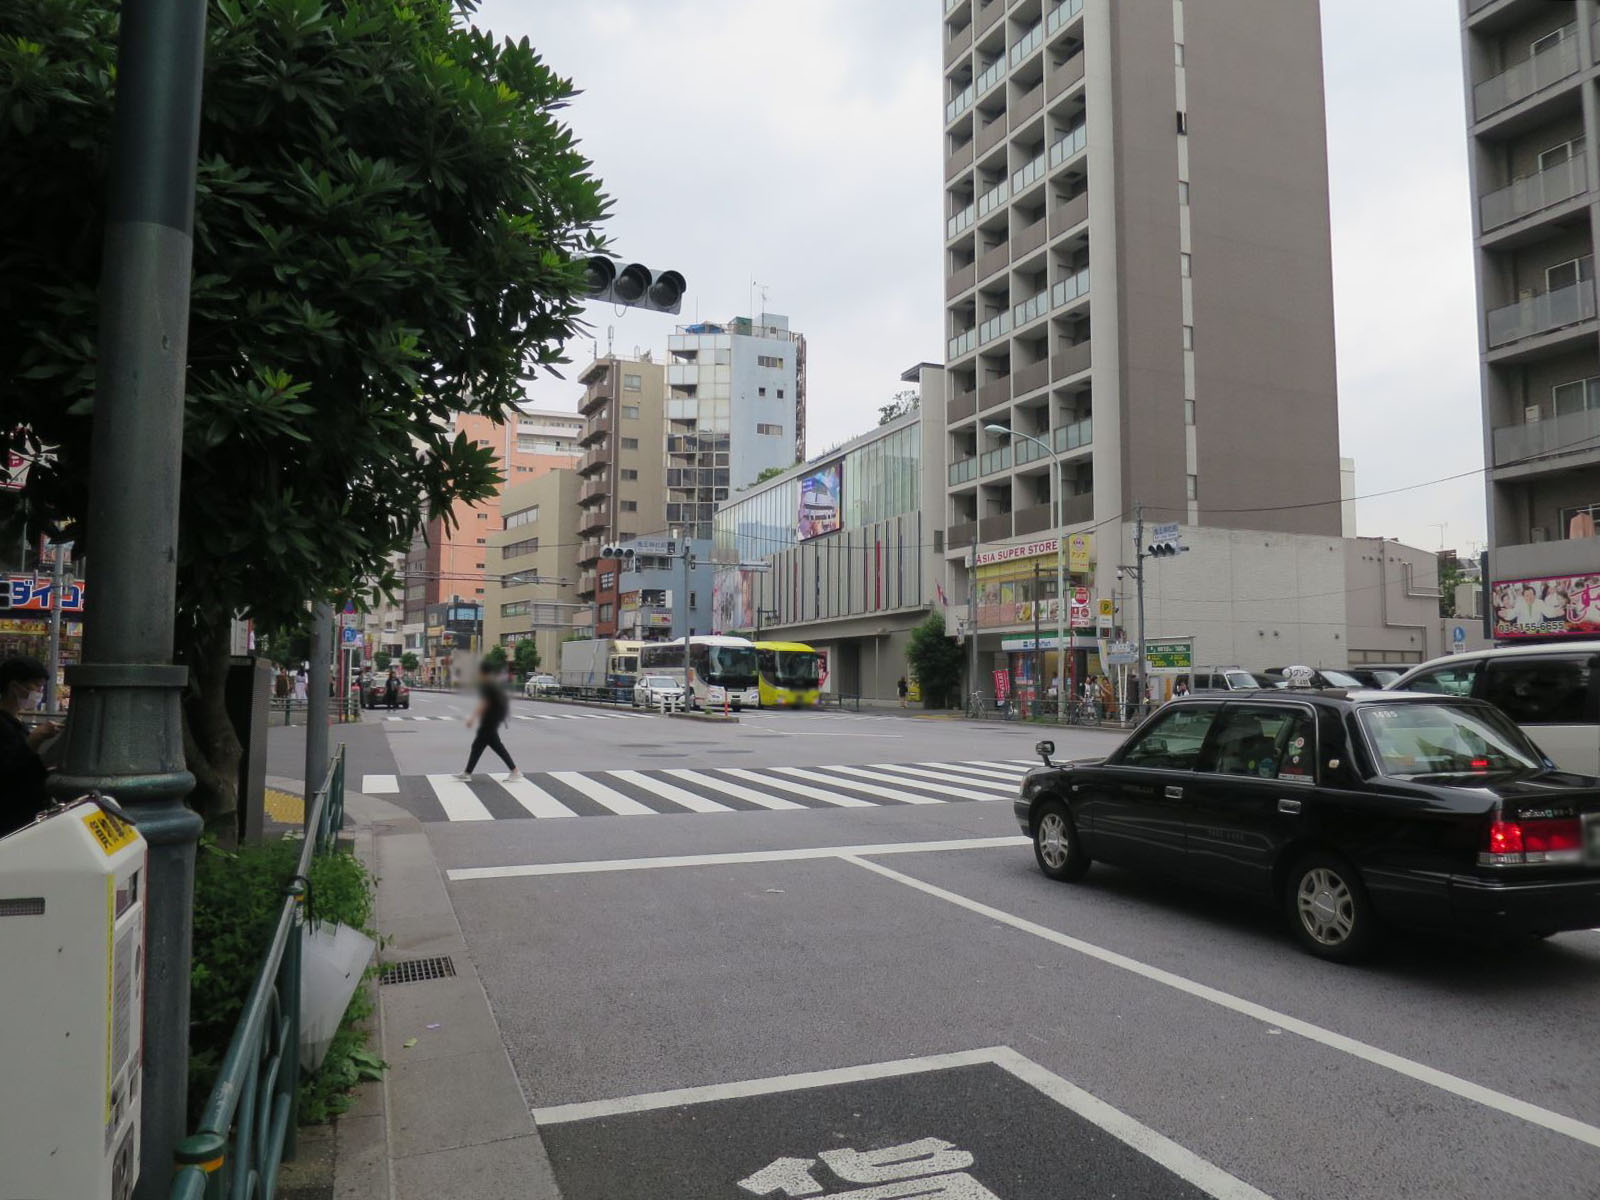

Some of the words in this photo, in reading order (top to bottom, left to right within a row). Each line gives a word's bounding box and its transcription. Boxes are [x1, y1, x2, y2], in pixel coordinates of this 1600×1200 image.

[976, 553, 995, 564] ASIA
[997, 548, 1026, 561] SUPER
[1028, 540, 1059, 555] STORE
[12, 580, 84, 608] ダイコ
[1499, 621, 1565, 633] 03-5155-6655
